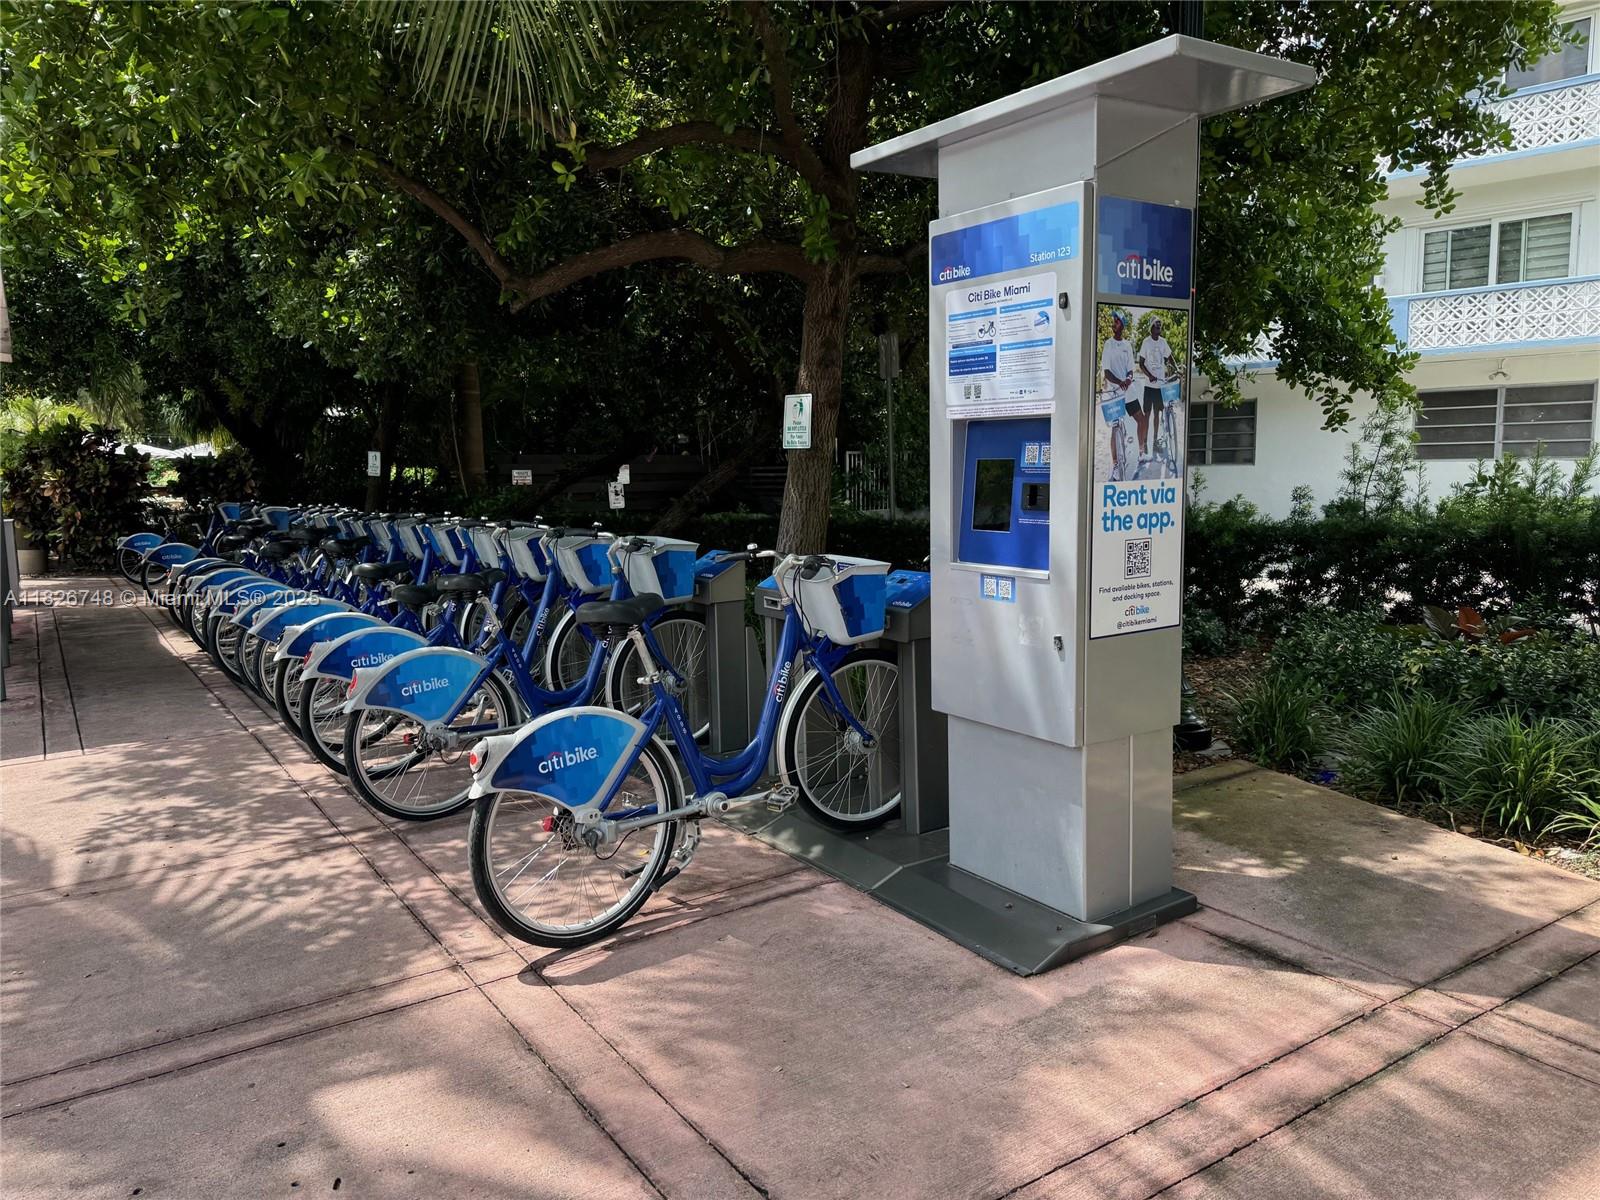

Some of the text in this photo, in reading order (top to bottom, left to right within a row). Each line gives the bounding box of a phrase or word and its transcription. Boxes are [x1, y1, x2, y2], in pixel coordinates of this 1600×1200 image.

[1030, 246, 1071, 263] Station 123
[953, 265, 971, 278] bike
[1117, 258, 1173, 282] citi bike
[968, 292, 982, 303] Citi
[983, 289, 1001, 300] Bike
[1003, 282, 1031, 297] Miami
[1103, 481, 1176, 508] Rent via
[1102, 509, 1175, 535] the app.
[1112, 583, 1135, 593] available
[1152, 579, 1174, 588] stations,
[1112, 594, 1123, 602] and
[1123, 592, 1144, 601] docking
[1124, 605, 1150, 617] citi bike
[1116, 616, 1157, 630] @citibikemiami
[350, 657, 369, 668] citi
[777, 661, 791, 684] bike
[401, 677, 449, 696] citi bike
[538, 746, 598, 774] citi bike
